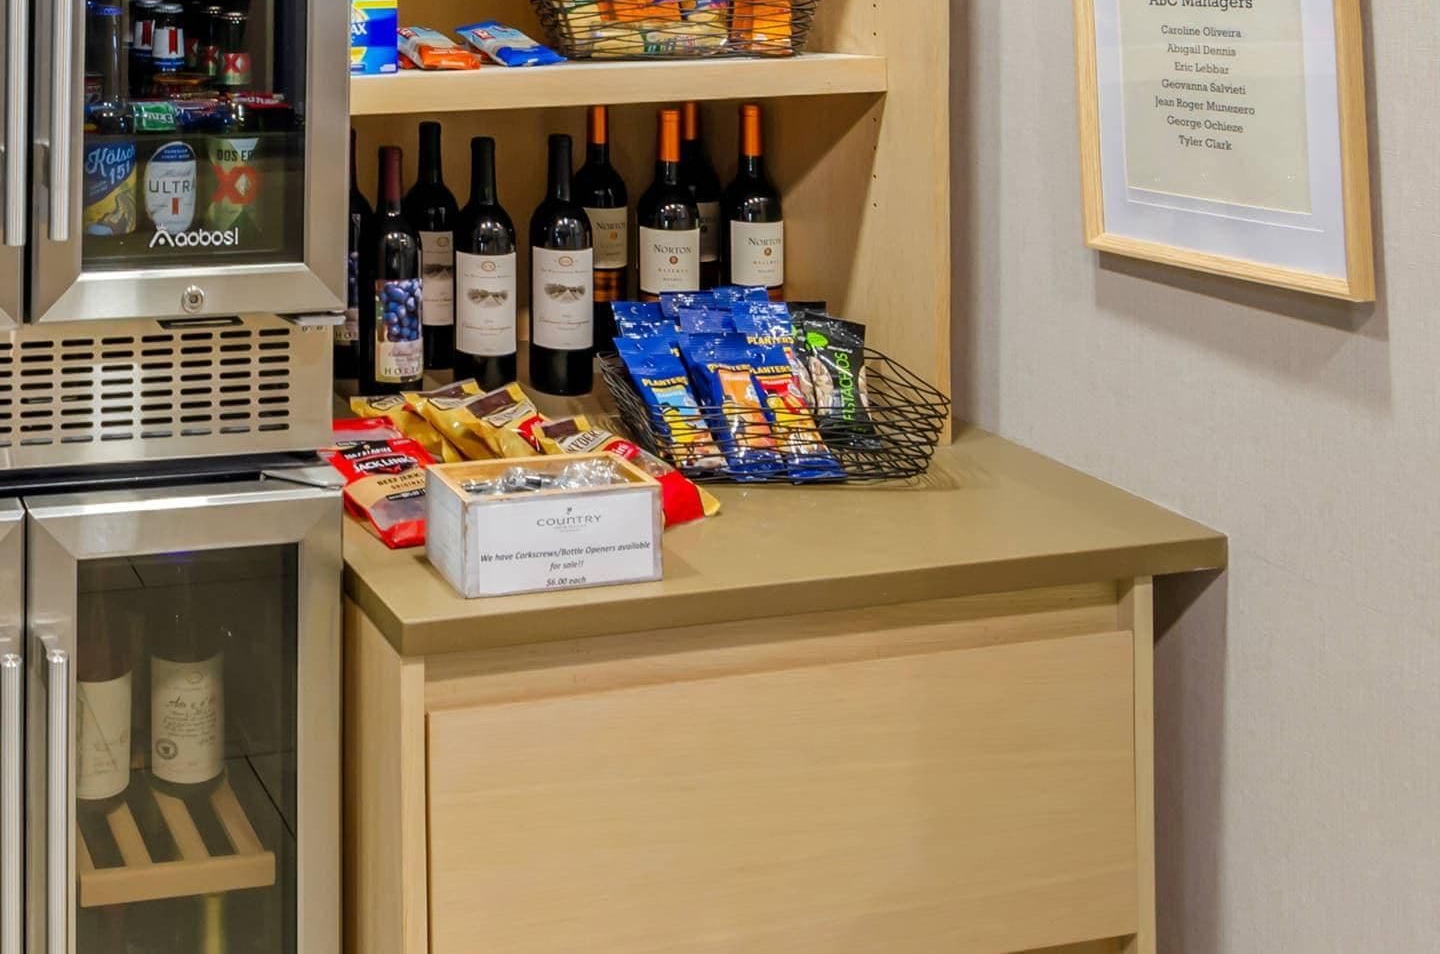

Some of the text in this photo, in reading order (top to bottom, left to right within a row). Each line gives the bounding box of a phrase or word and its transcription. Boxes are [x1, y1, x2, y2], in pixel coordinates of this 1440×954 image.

[1161, 25, 1242, 38] Caroline Oliveira
[1167, 44, 1237, 58] Abigail Dennis
[1174, 61, 1230, 75] Eric Lebbar
[1161, 79, 1208, 92] Geovanna
[1155, 96, 1175, 108] Jean
[1176, 98, 1204, 111] Roger
[1166, 115, 1202, 129] George
[1178, 134, 1232, 151] Tyler Clark
[216, 149, 238, 162] DOS
[654, 244, 692, 255] NORTON
[748, 335, 795, 345] PLANTERS
[642, 376, 689, 387] PLANTERS
[536, 514, 602, 527] COUNTRY
[480, 541, 651, 562] We have Corkscrews/Bottle Openers available
[549, 560, 584, 571] for sale!!
[569, 576, 587, 584] each
